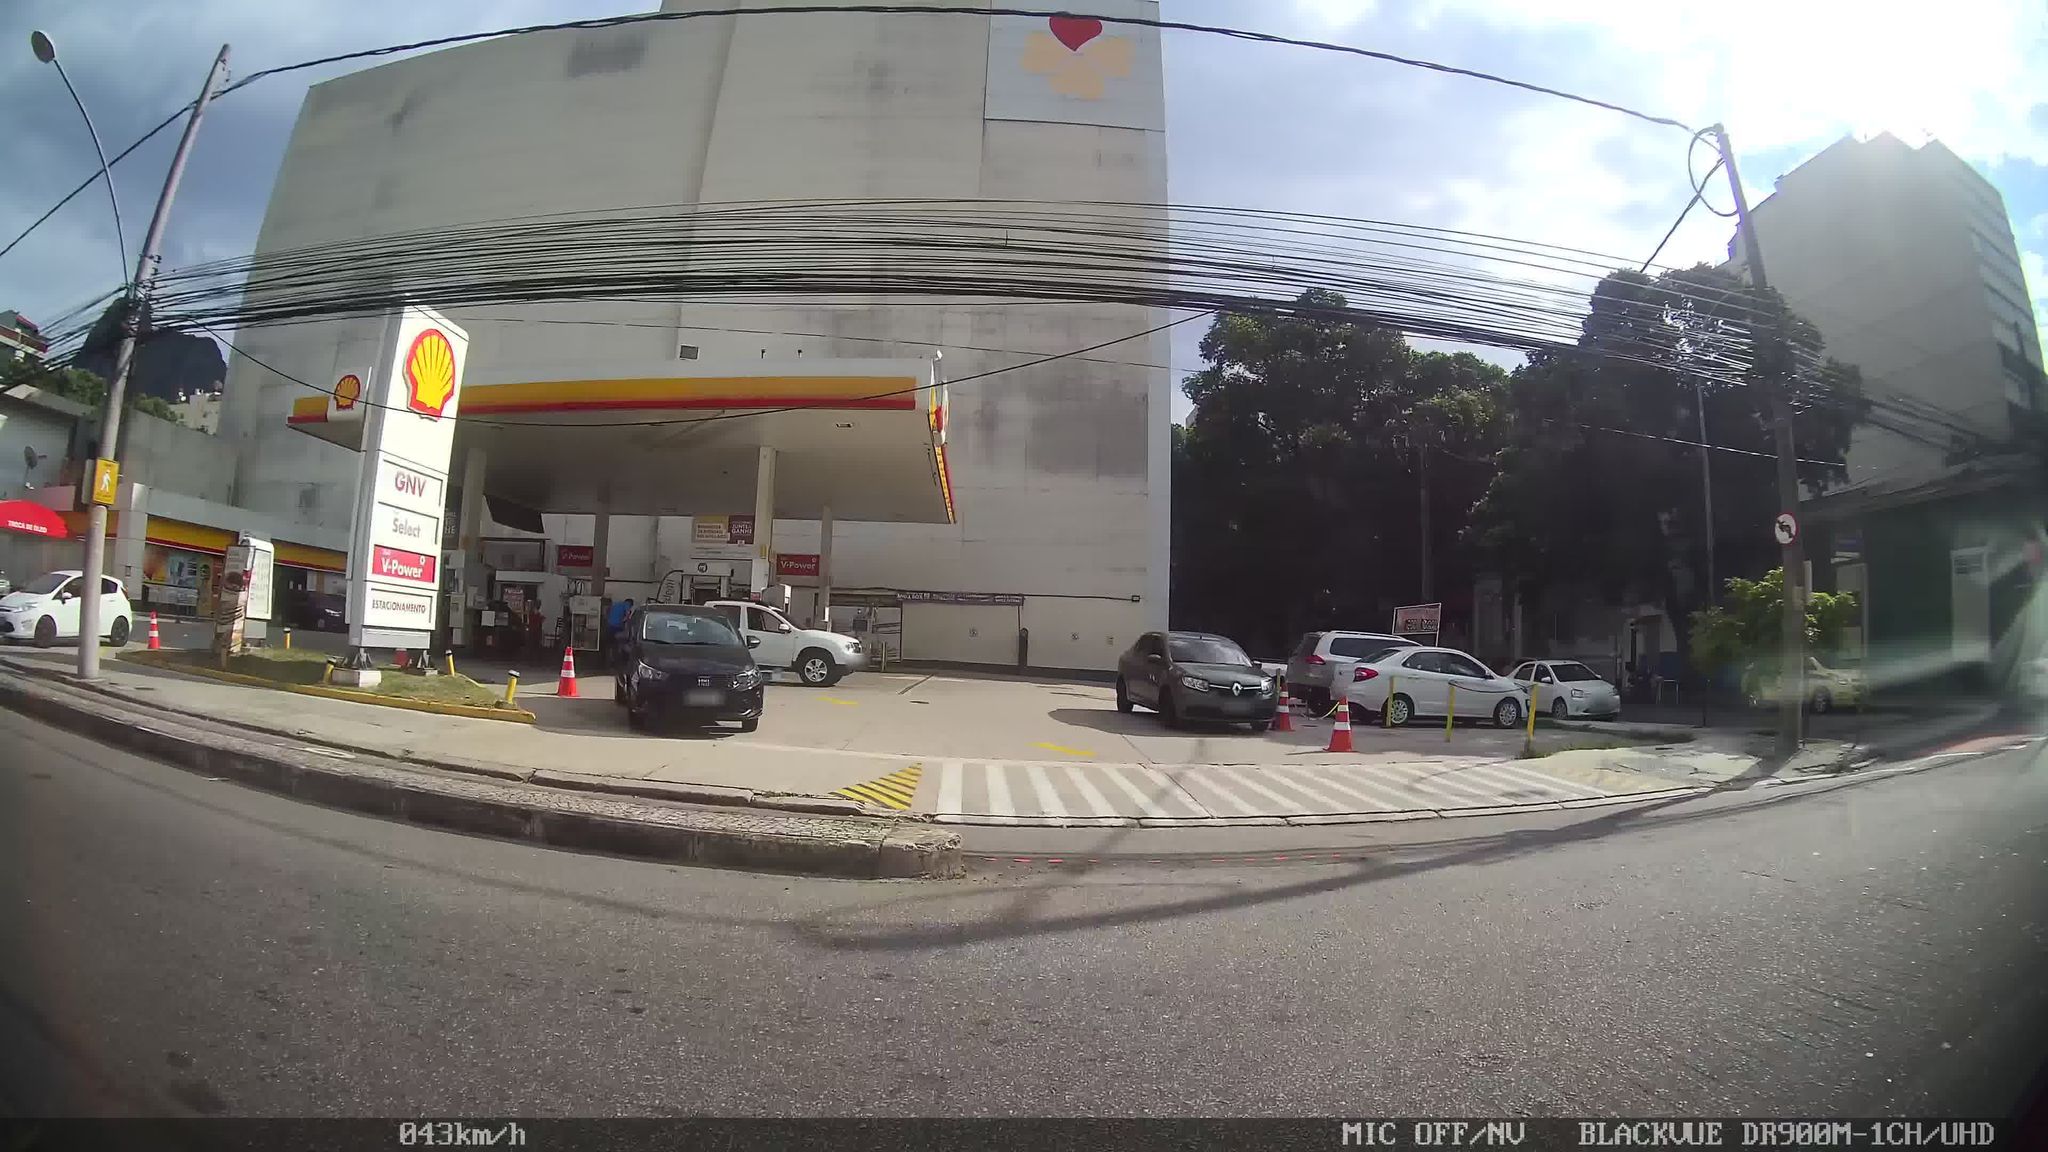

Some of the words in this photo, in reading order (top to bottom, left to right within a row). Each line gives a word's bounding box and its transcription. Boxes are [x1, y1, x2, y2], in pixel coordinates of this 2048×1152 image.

[395, 471, 426, 497] GNV
[392, 517, 421, 538] Select
[382, 557, 423, 578] V-Power
[780, 561, 816, 569] V-Power
[372, 599, 426, 614] ESTACIONAMENTO
